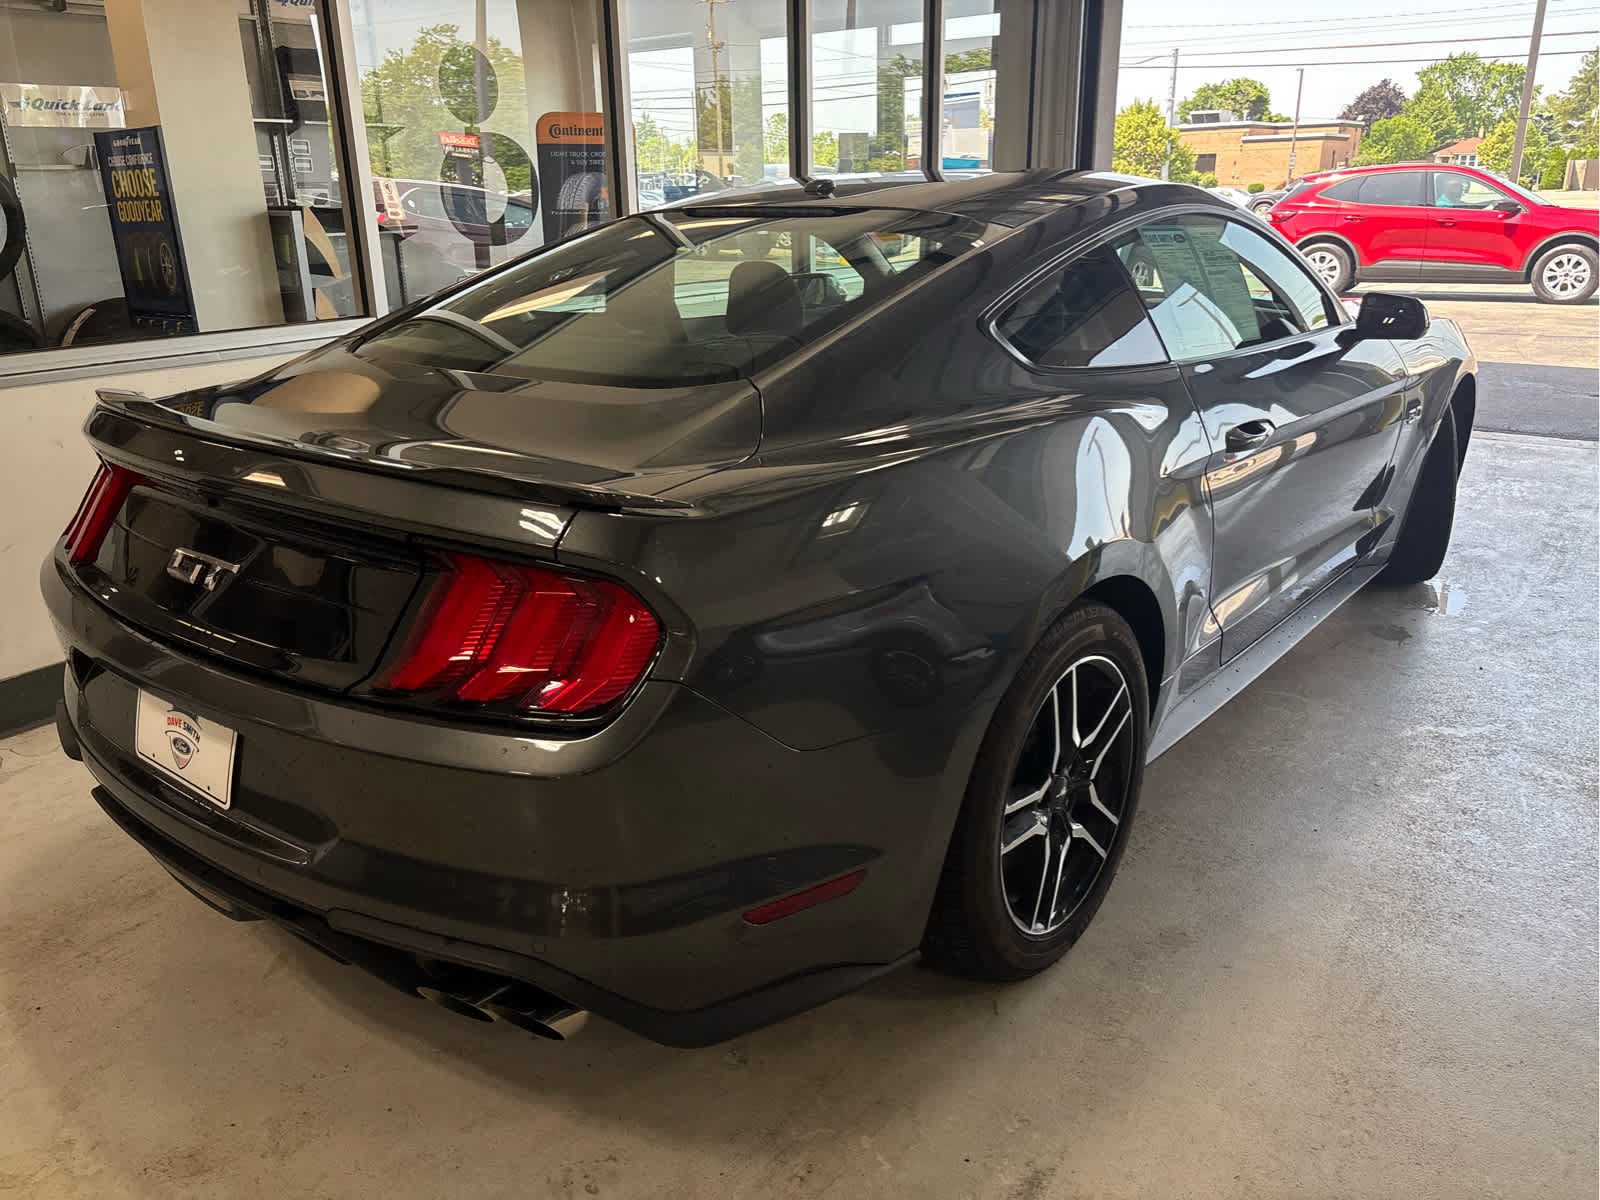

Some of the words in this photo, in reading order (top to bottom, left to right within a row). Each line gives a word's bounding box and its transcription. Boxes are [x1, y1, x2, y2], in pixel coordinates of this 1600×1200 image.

[31, 97, 81, 111] Quick
[549, 123, 605, 139] Continent
[111, 168, 160, 199] CHOOSE
[117, 200, 165, 222] GOODYEAR
[167, 547, 241, 592] GT
[167, 716, 182, 728] DAVE
[183, 721, 201, 744] SMITH
